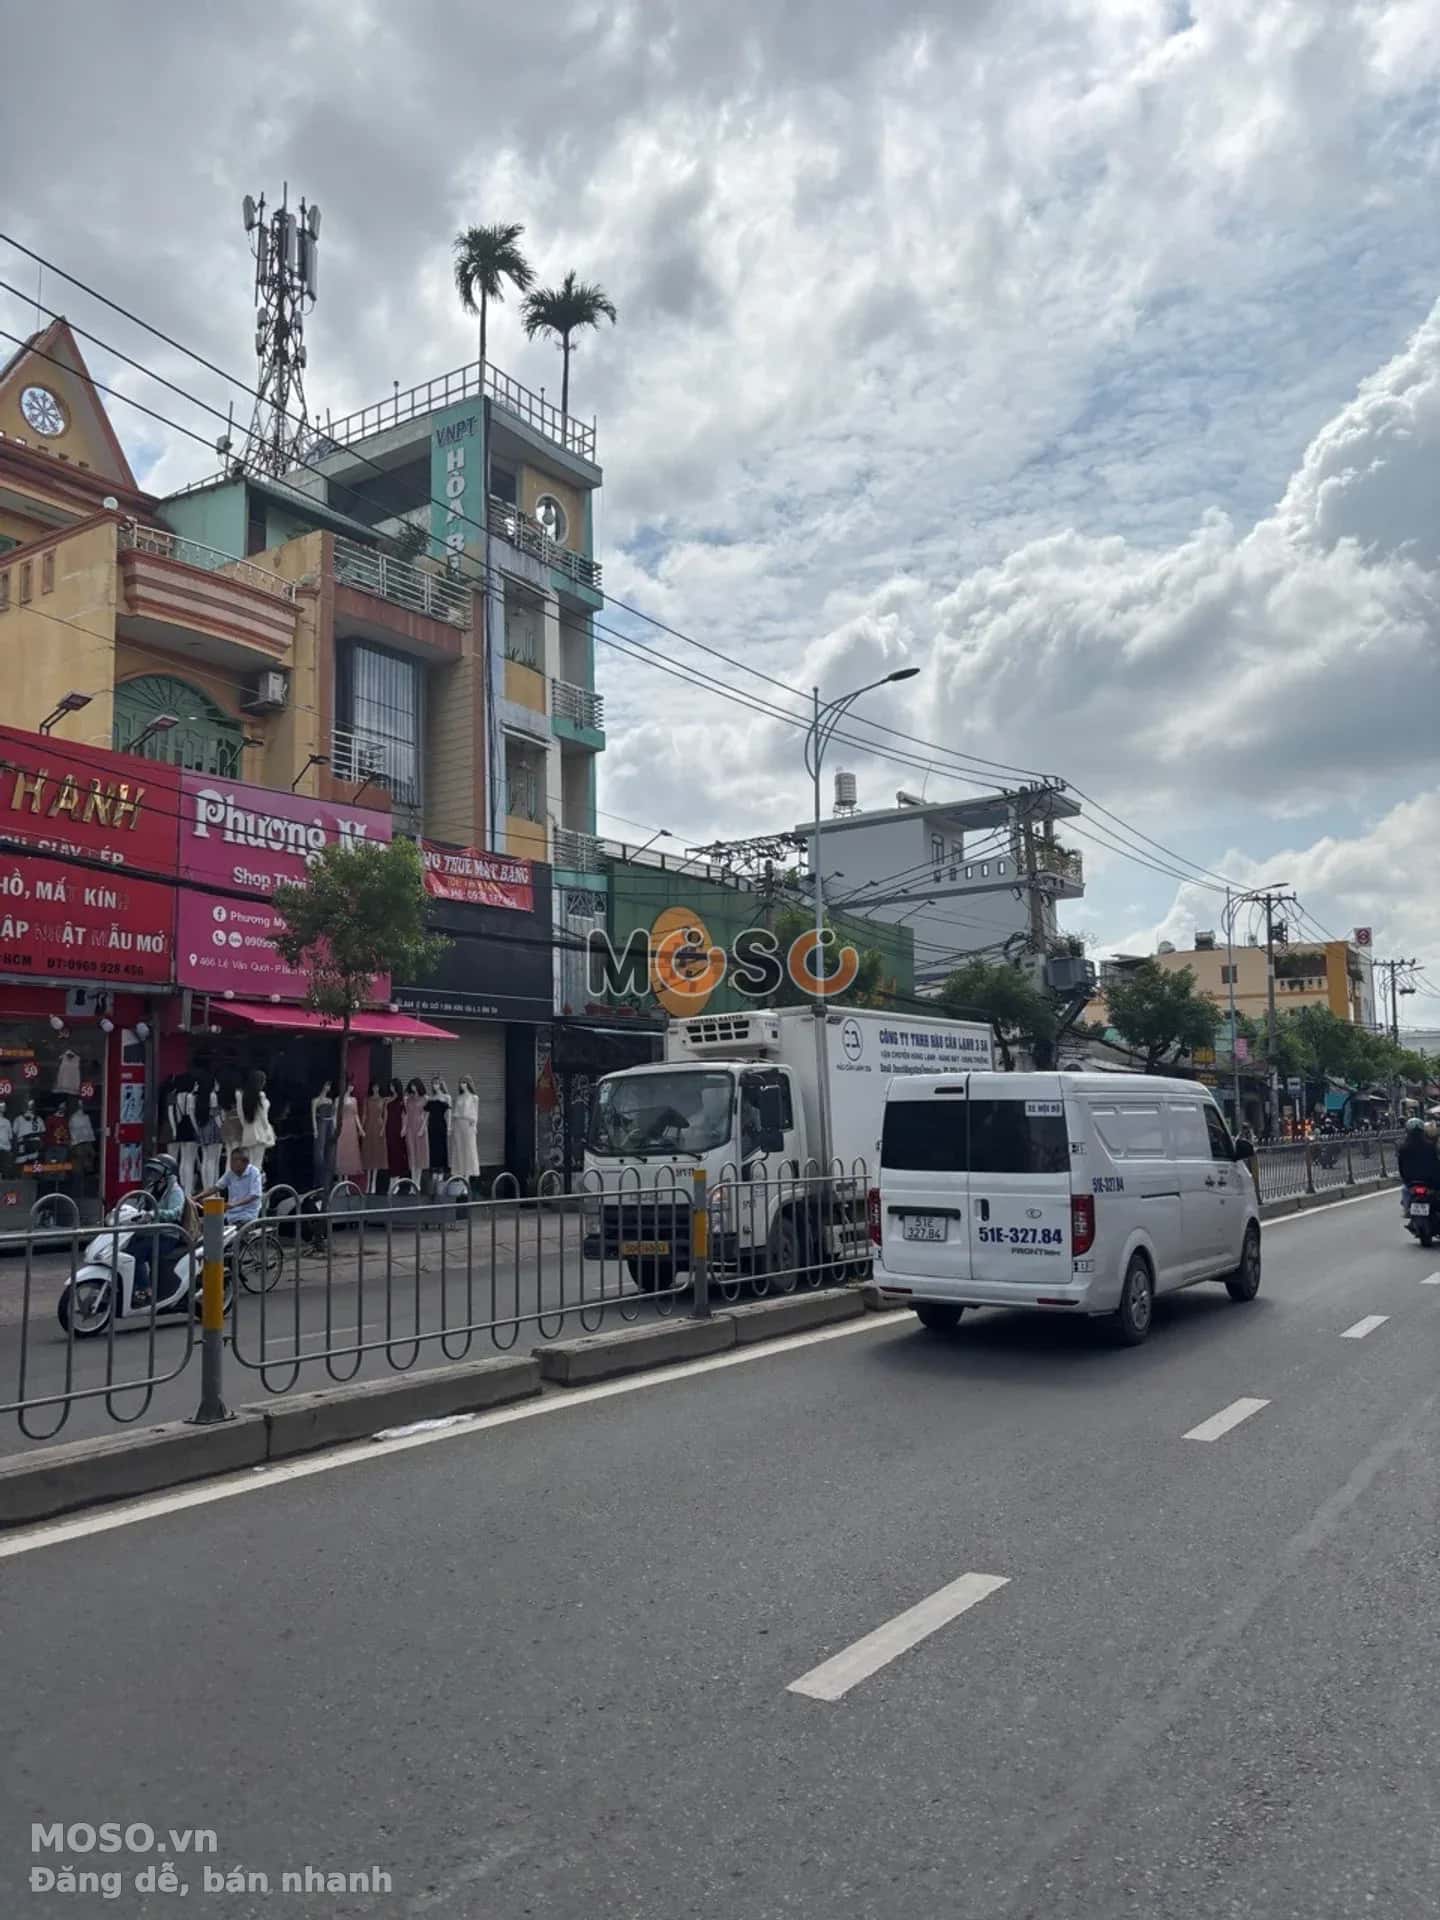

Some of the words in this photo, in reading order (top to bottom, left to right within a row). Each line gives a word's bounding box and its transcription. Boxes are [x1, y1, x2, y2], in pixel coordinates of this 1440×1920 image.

[436, 417, 477, 448] VNPT
[233, 866, 271, 890] Shop
[24, 1067, 38, 1078] 50
[81, 1086, 94, 1097] 50
[915, 1217, 935, 1227] 51E
[908, 1227, 941, 1239] 327.84
[978, 1226, 1063, 1245] 51E-327.84
